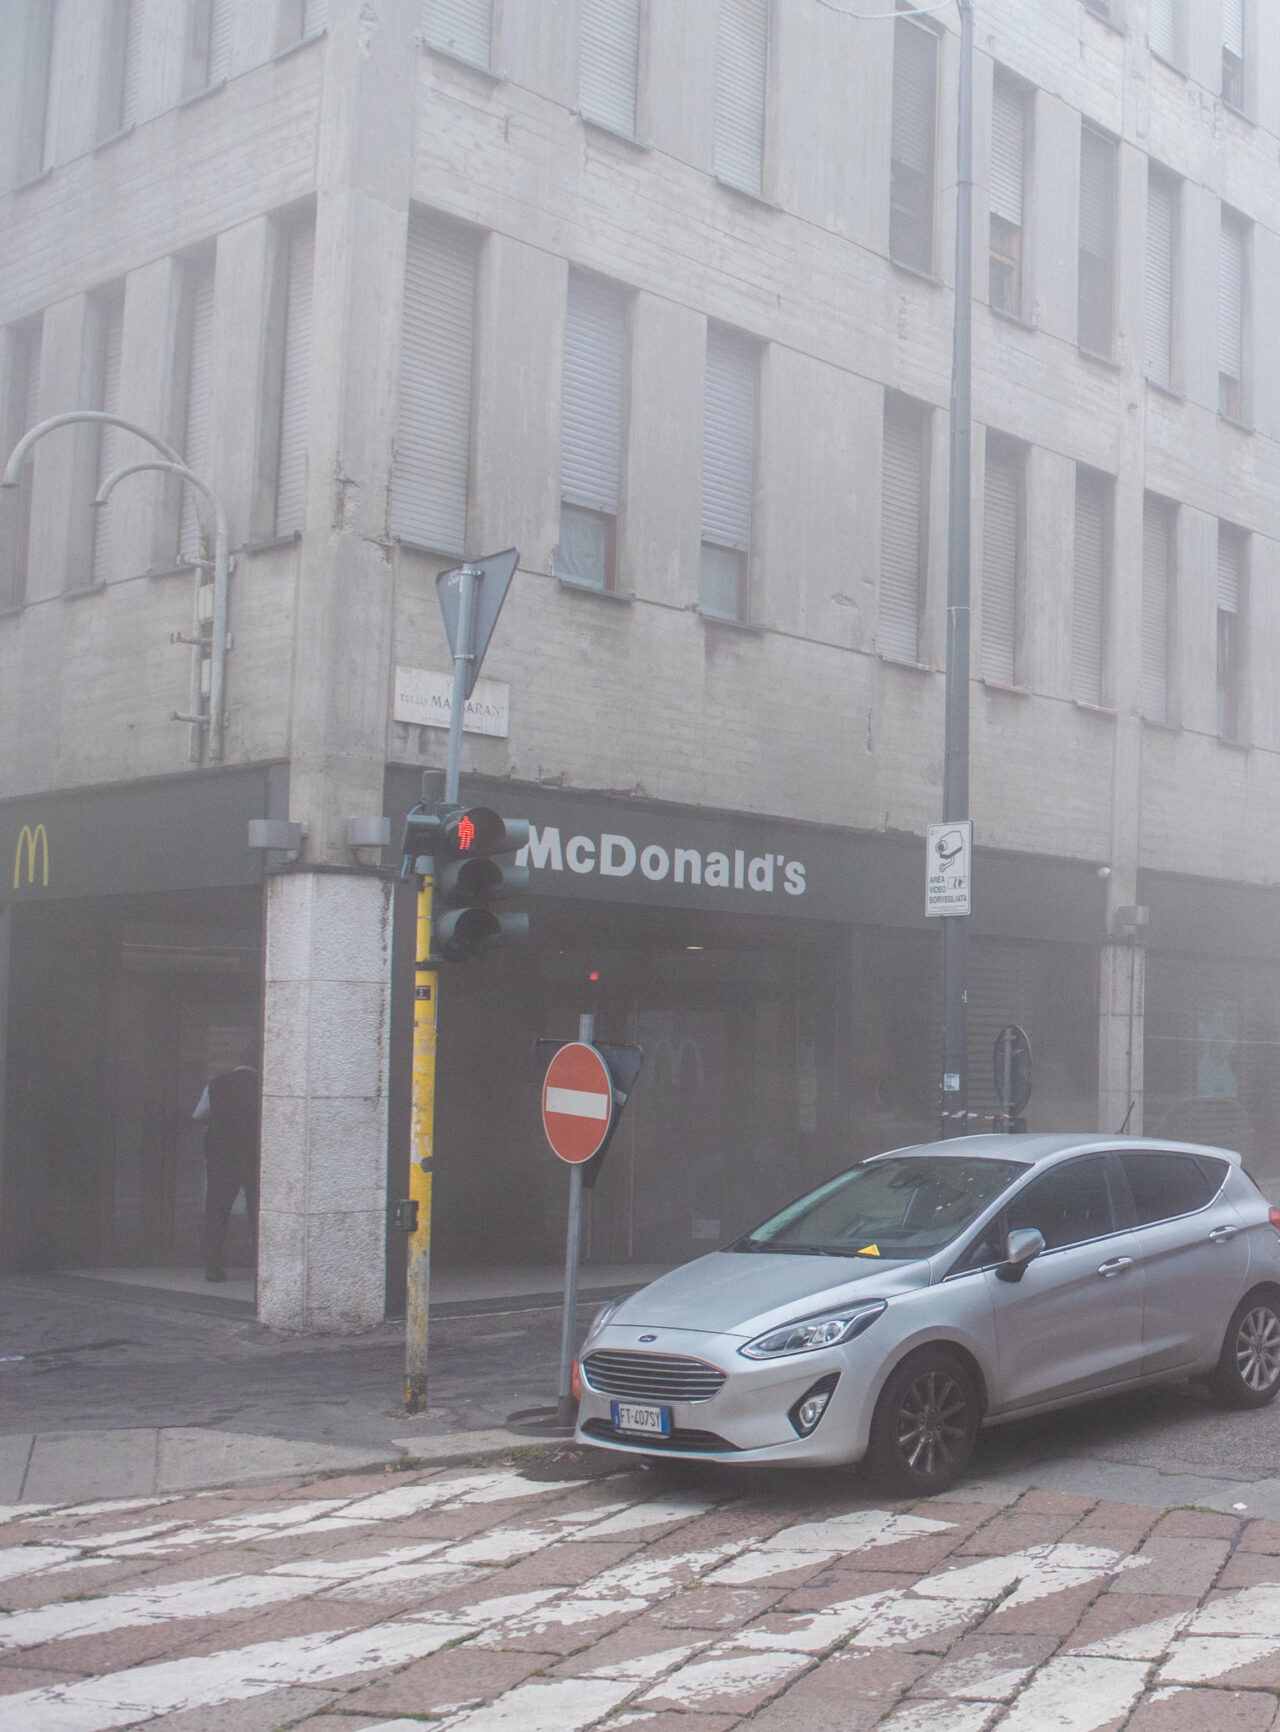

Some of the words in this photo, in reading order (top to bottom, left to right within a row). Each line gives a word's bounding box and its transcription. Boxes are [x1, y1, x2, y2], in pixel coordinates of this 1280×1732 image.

[515, 824, 806, 895] McDonald's
[930, 876, 945, 884] AREA
[929, 886, 946, 894] VIDEO
